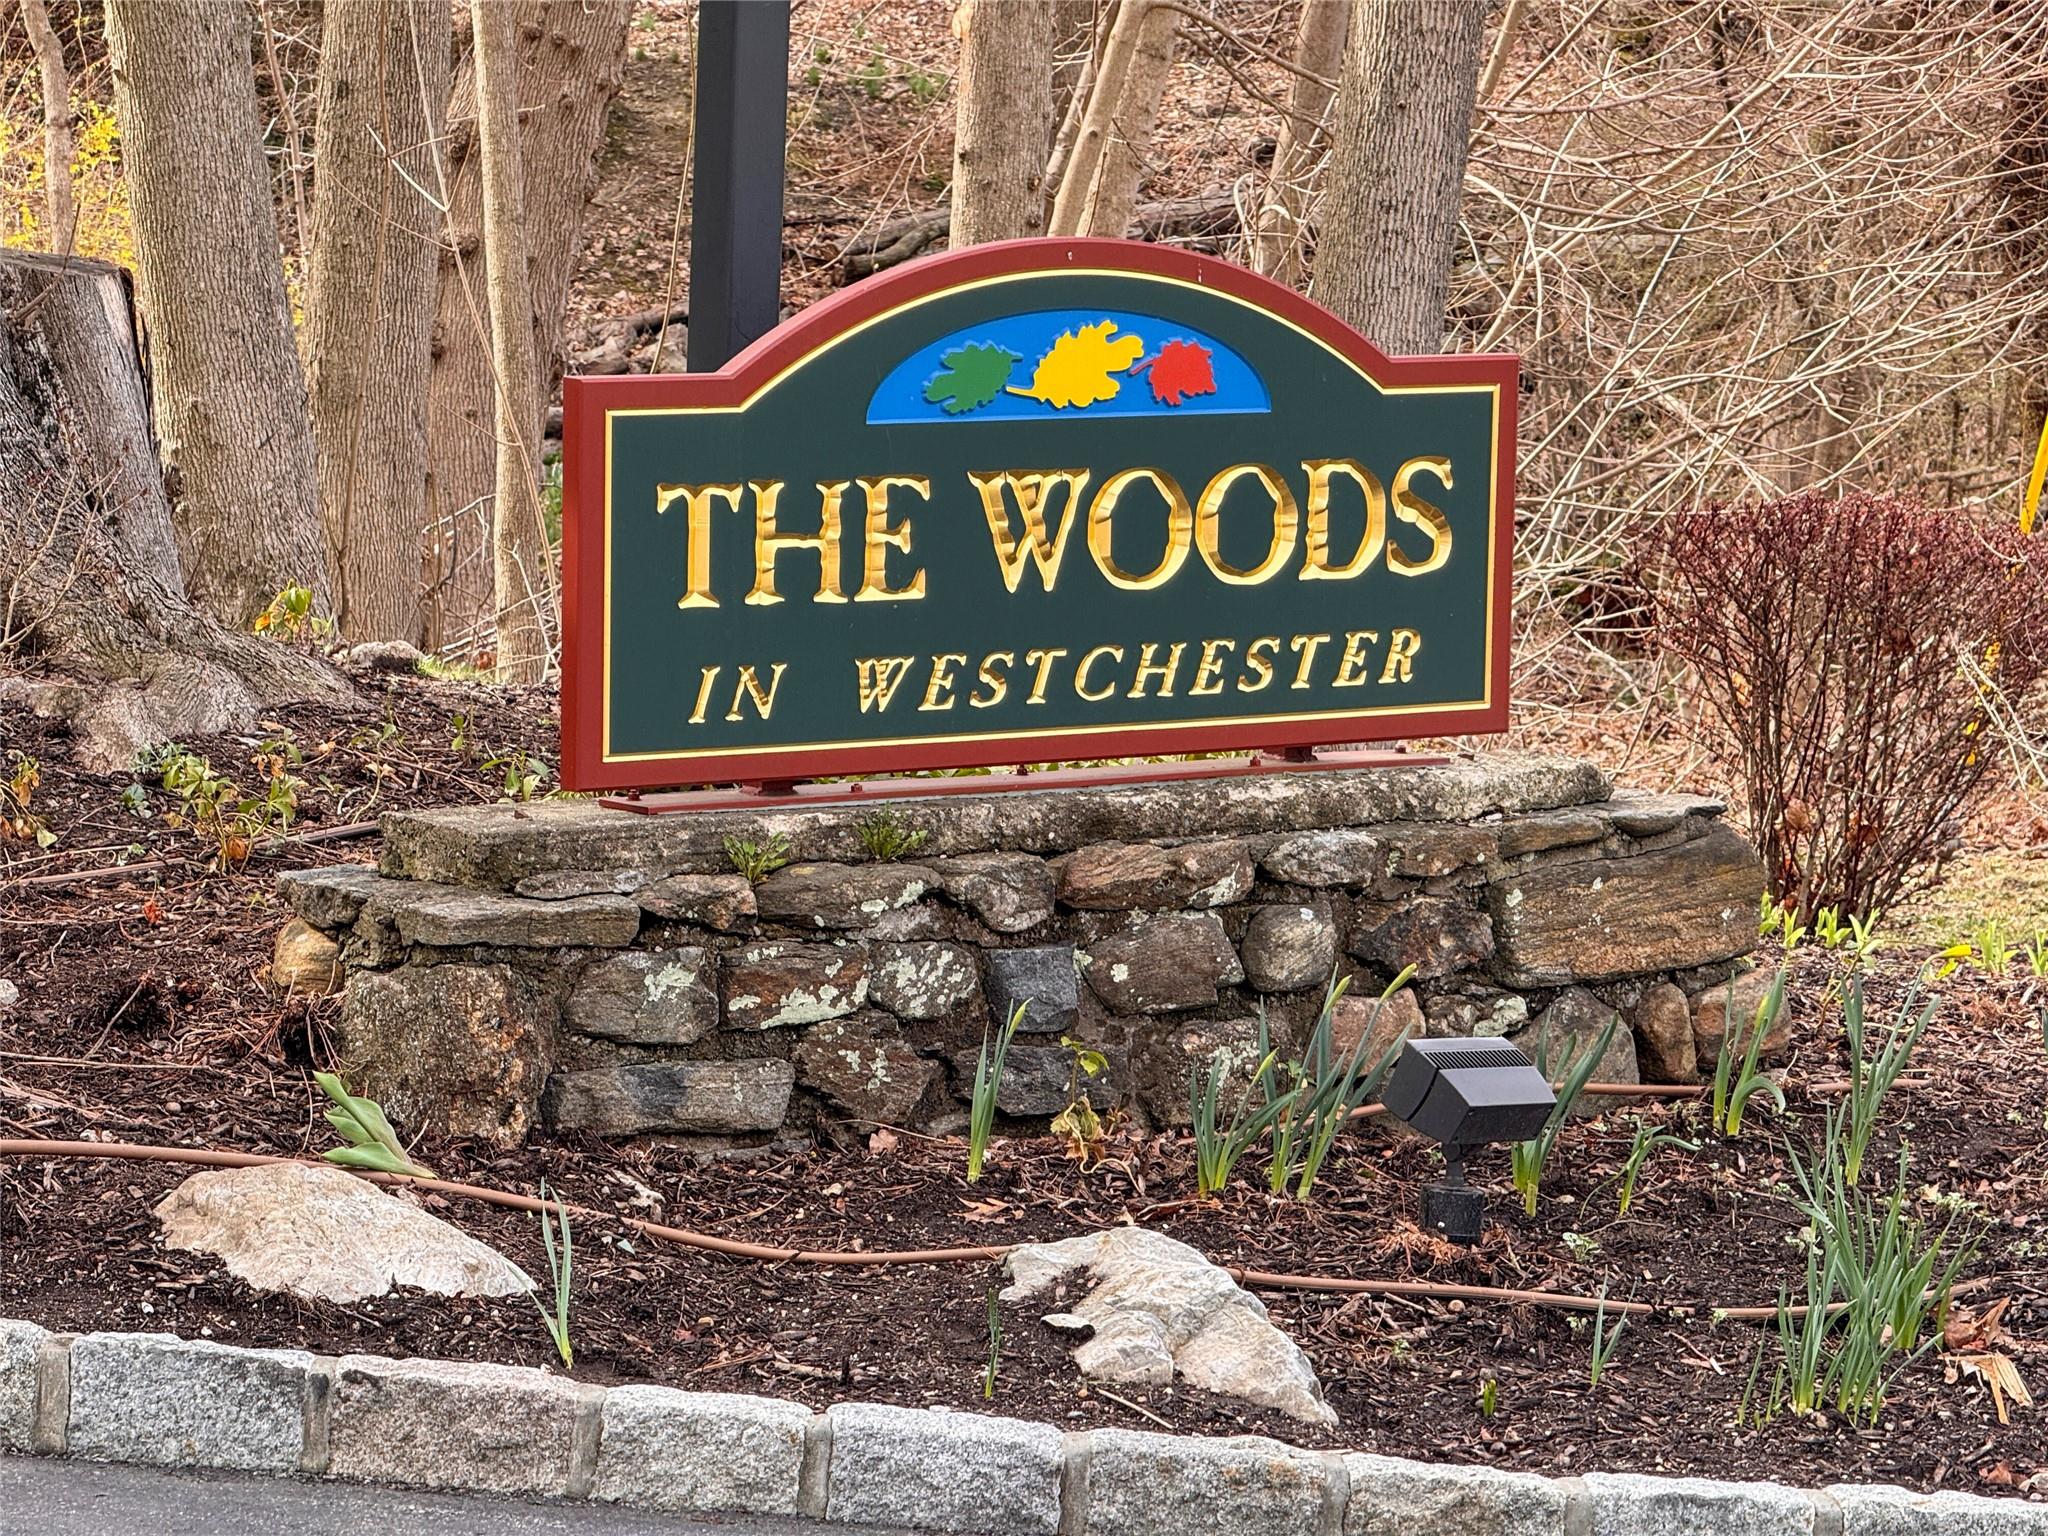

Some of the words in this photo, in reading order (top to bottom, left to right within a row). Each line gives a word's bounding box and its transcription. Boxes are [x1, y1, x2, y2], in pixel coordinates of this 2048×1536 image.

[656, 473, 931, 609] THE
[966, 455, 1454, 593] WOODS
[688, 662, 787, 724] IN
[855, 627, 1422, 713] WESTCHESTER
